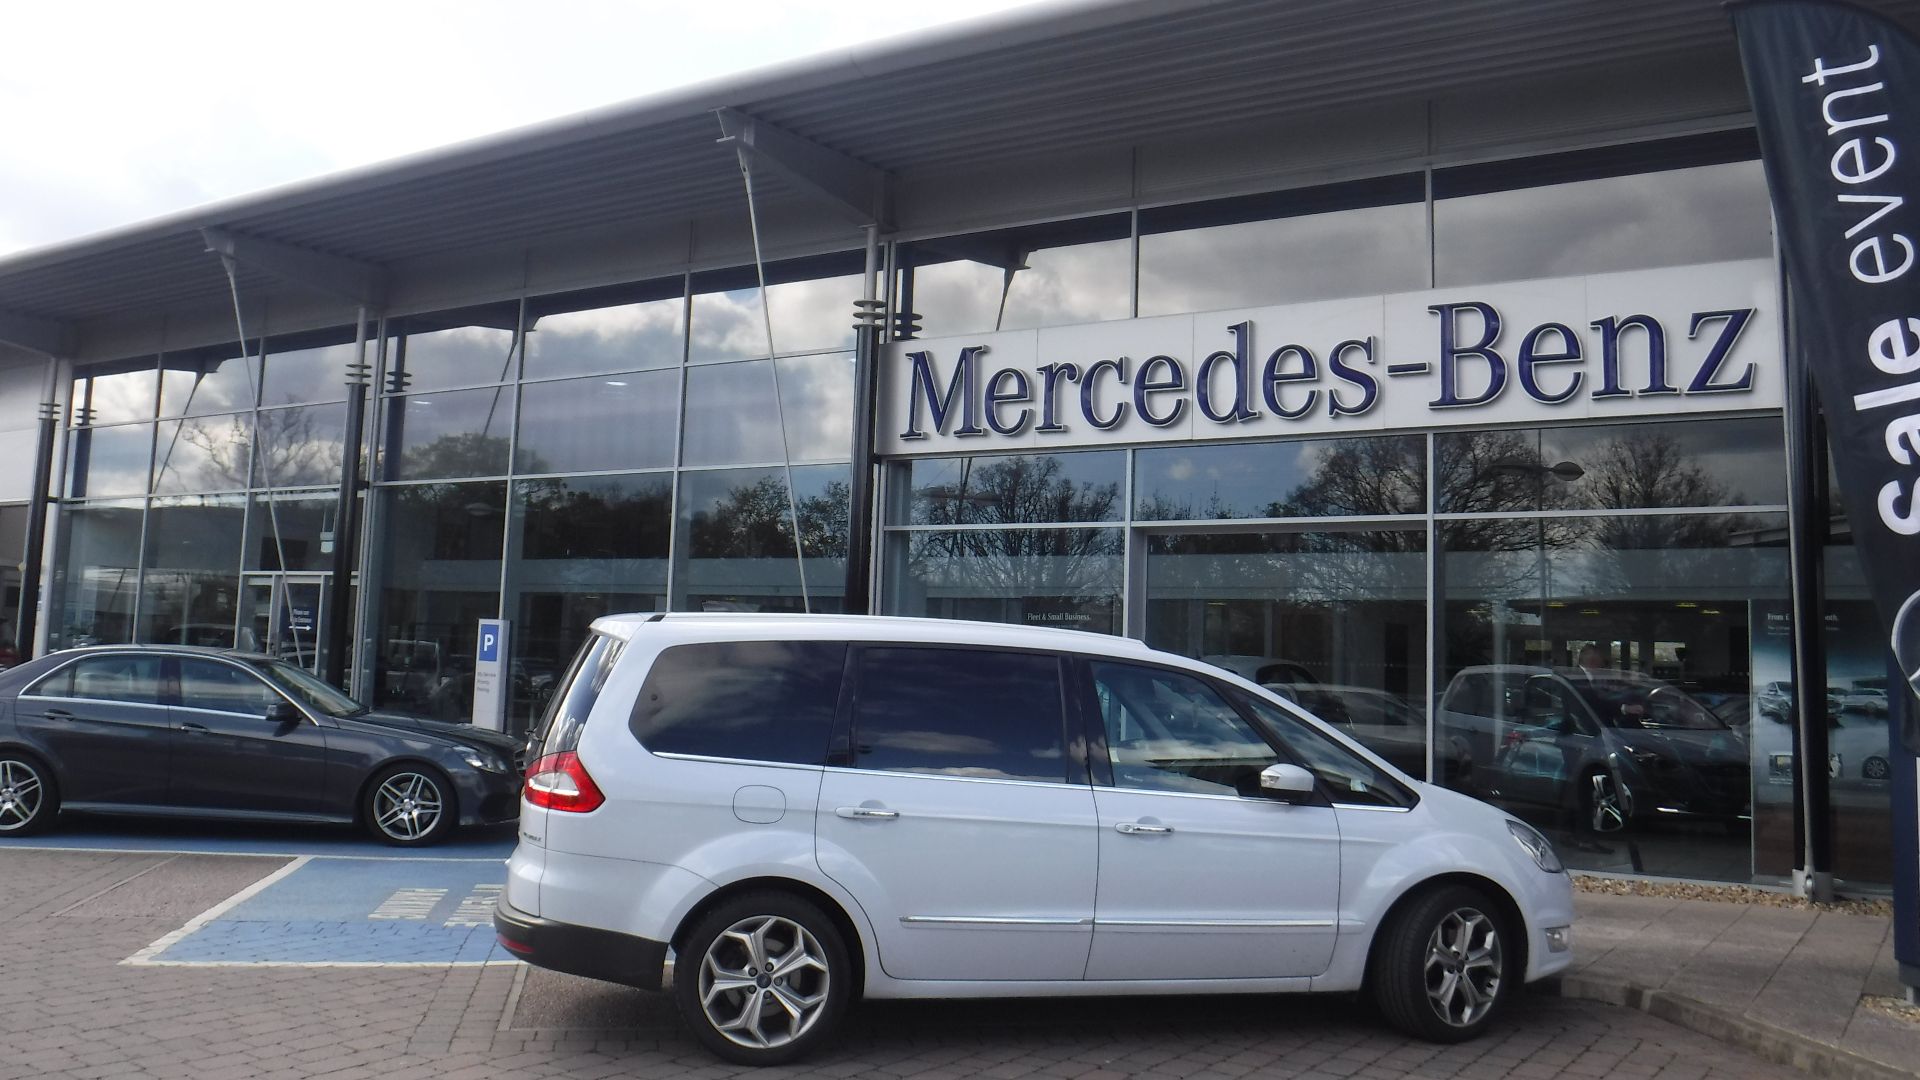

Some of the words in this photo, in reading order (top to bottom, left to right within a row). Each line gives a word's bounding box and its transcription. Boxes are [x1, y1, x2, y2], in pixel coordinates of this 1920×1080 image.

[1801, 44, 1914, 284] event
[899, 300, 1758, 442] Mercedes-Benz
[483, 633, 494, 651] P
[1027, 612, 1041, 621] Fleet
[1047, 611, 1064, 621] Small
